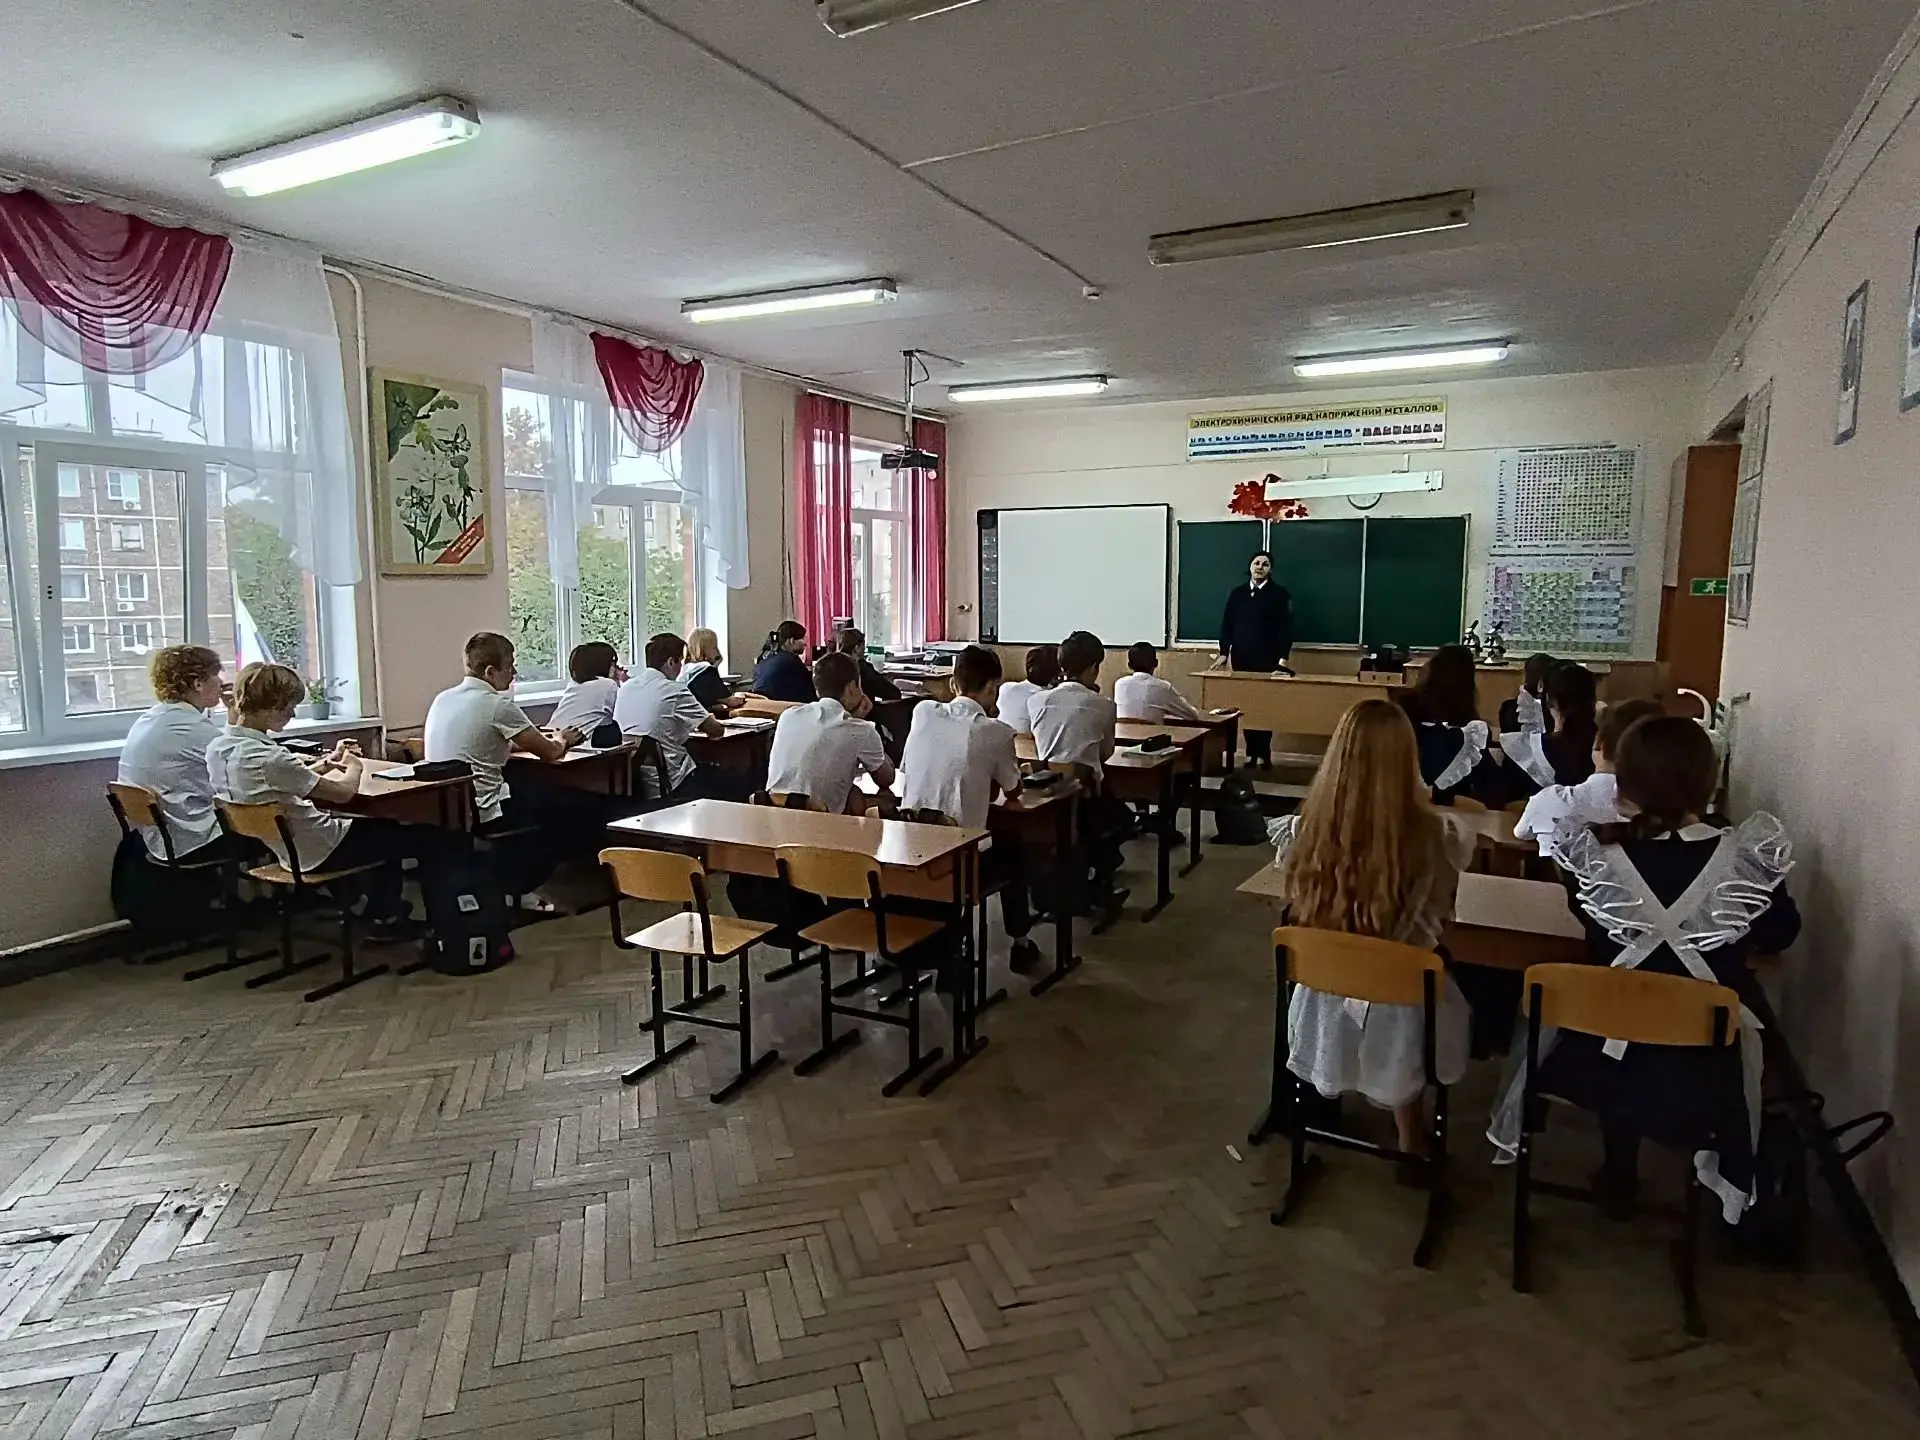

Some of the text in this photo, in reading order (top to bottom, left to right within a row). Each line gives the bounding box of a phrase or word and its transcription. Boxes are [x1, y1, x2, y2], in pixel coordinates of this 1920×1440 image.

[1194, 404, 1438, 428] ЭЛЕКТРОХИМИЧЕСКИЙ РЯД НАПРЯЖЕНИЙ МЕТАЛЛОВ
